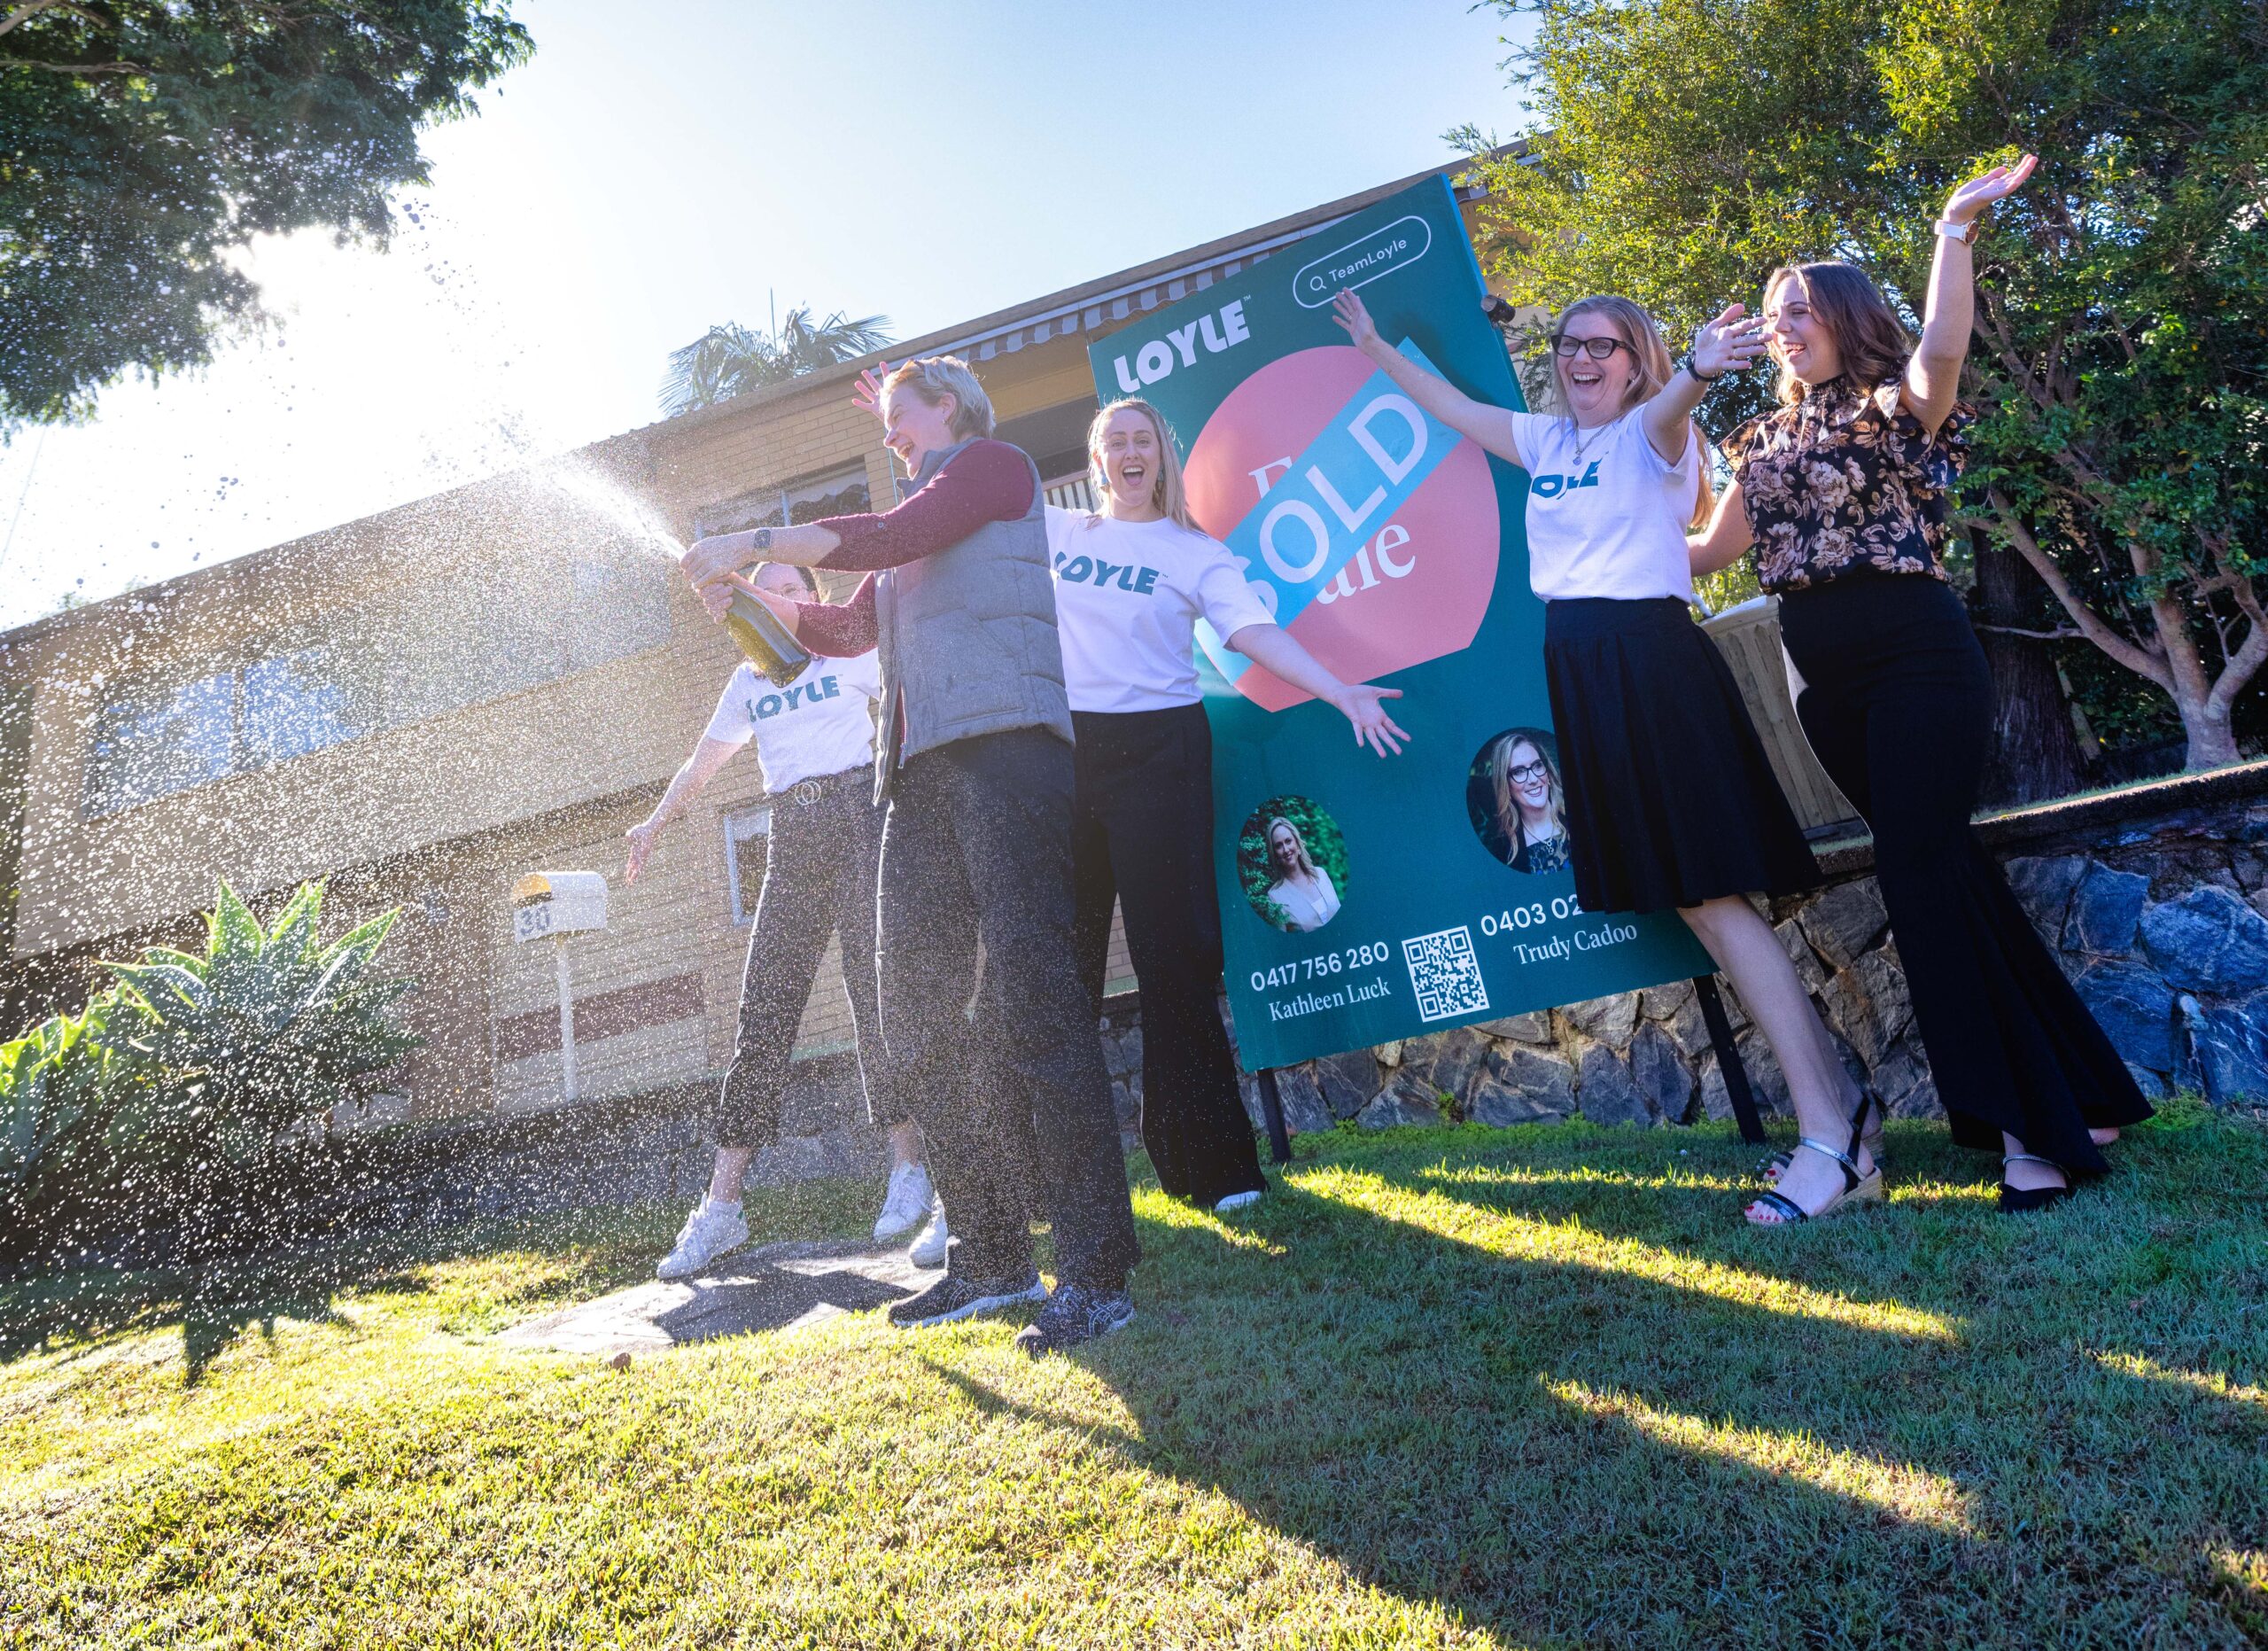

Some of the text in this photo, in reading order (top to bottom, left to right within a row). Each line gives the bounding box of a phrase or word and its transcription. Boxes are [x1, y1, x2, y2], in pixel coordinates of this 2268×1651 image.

[1329, 239, 1407, 282] TeamLoyle
[1114, 300, 1251, 393] LOYLE
[520, 905, 550, 936] 30
[1480, 894, 1586, 937] 0403 02
[1513, 923, 1637, 965] Trudy Cadoo
[1251, 941, 1389, 992] 0417 756 280
[1269, 977, 1392, 1022] Kathleen Luck
